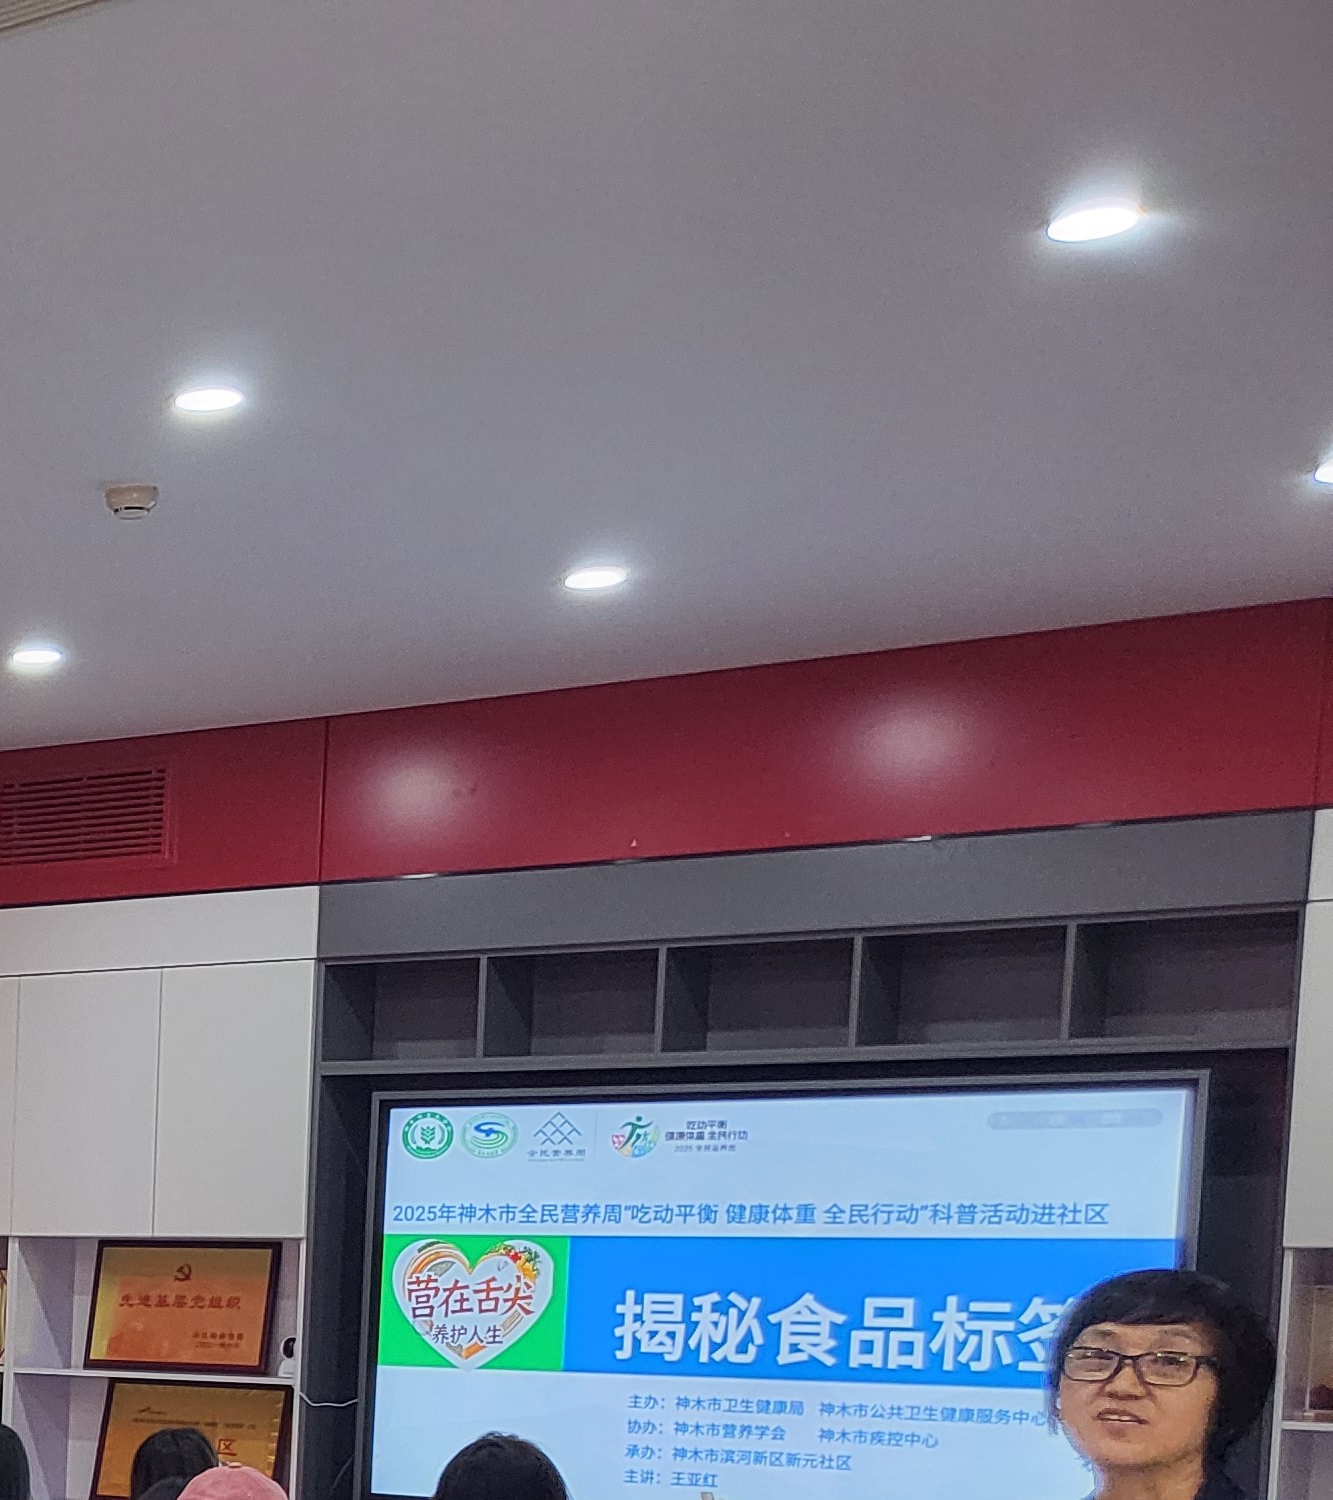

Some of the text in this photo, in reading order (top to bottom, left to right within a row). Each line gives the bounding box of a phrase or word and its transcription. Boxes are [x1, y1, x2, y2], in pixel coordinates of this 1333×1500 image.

[725, 1203, 817, 1225] 健康体重
[407, 1274, 535, 1320] 营在舌尖
[432, 1323, 504, 1344] 养护人生
[819, 1402, 1049, 1427] 神木市公共卫生健康服务中心
[818, 1428, 939, 1448] 神木市疾控中心
